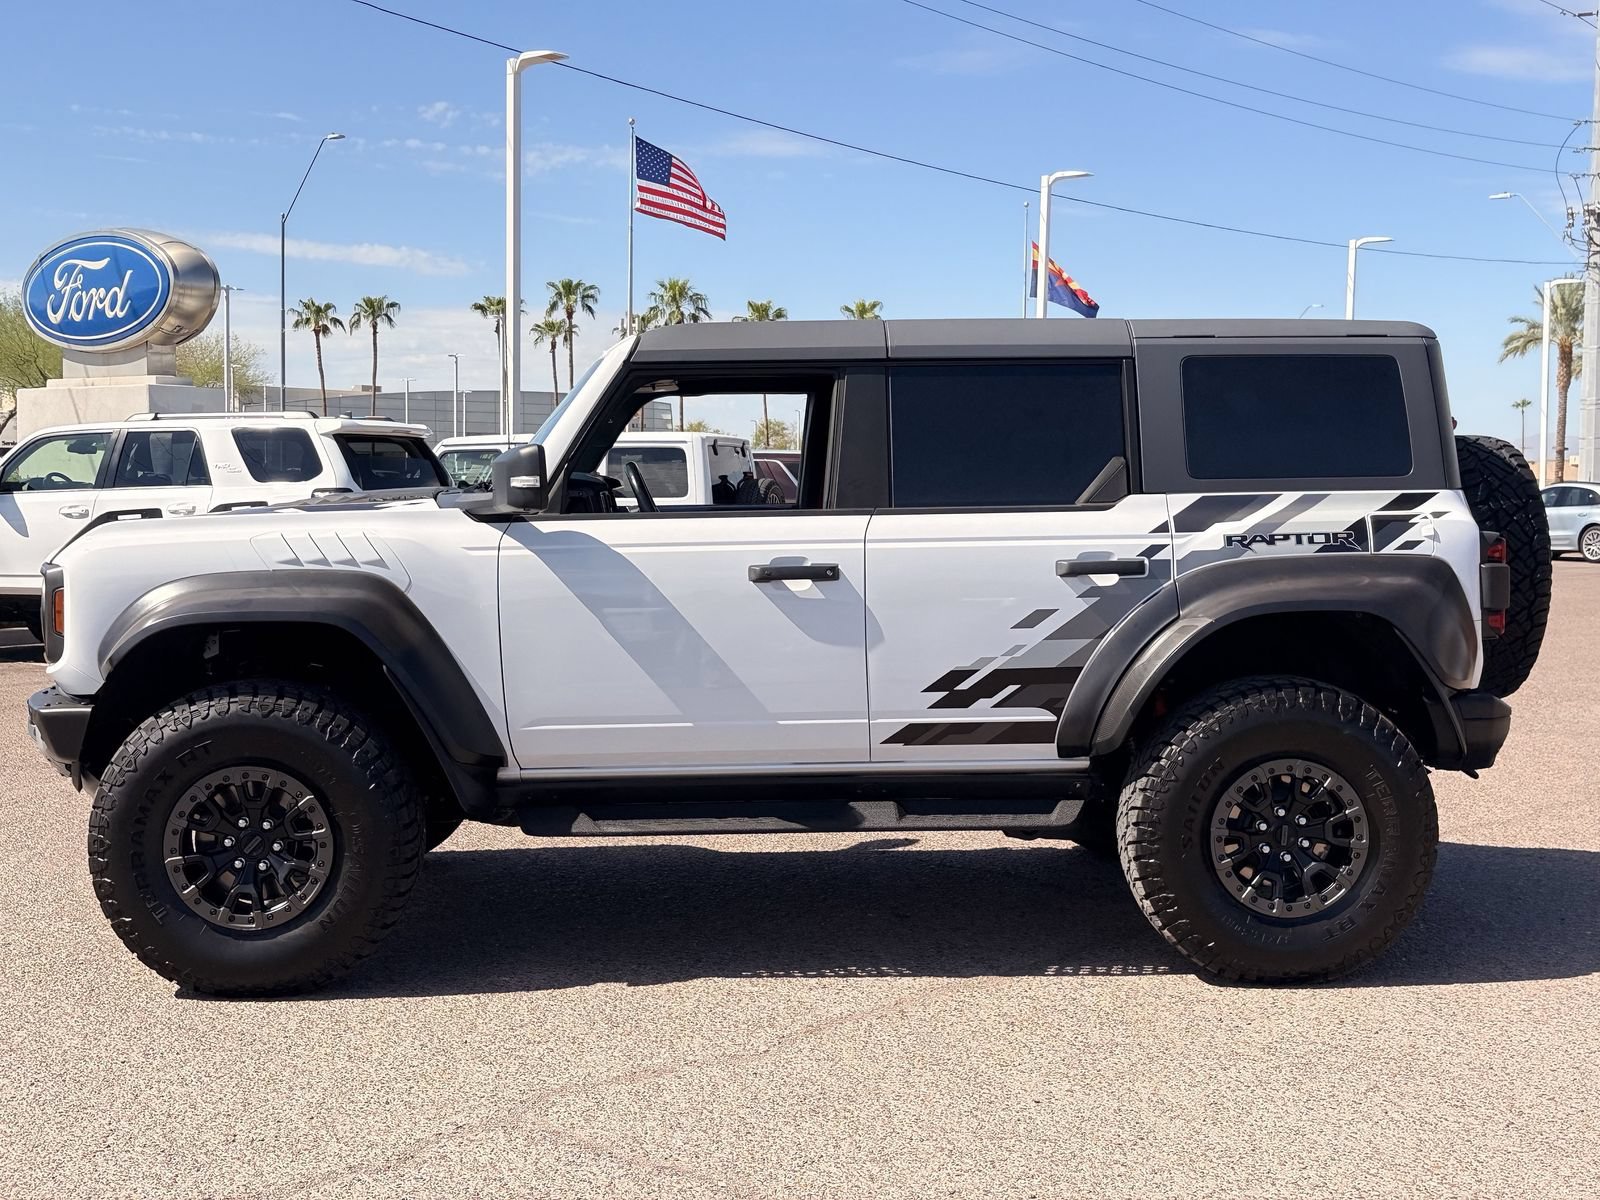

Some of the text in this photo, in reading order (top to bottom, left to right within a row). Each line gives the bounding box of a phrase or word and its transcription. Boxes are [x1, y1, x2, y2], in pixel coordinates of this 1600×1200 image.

[47, 257, 133, 324] Ford
[1223, 531, 1362, 553] RAPTOR
[130, 740, 213, 925] TERRAMAX RT
